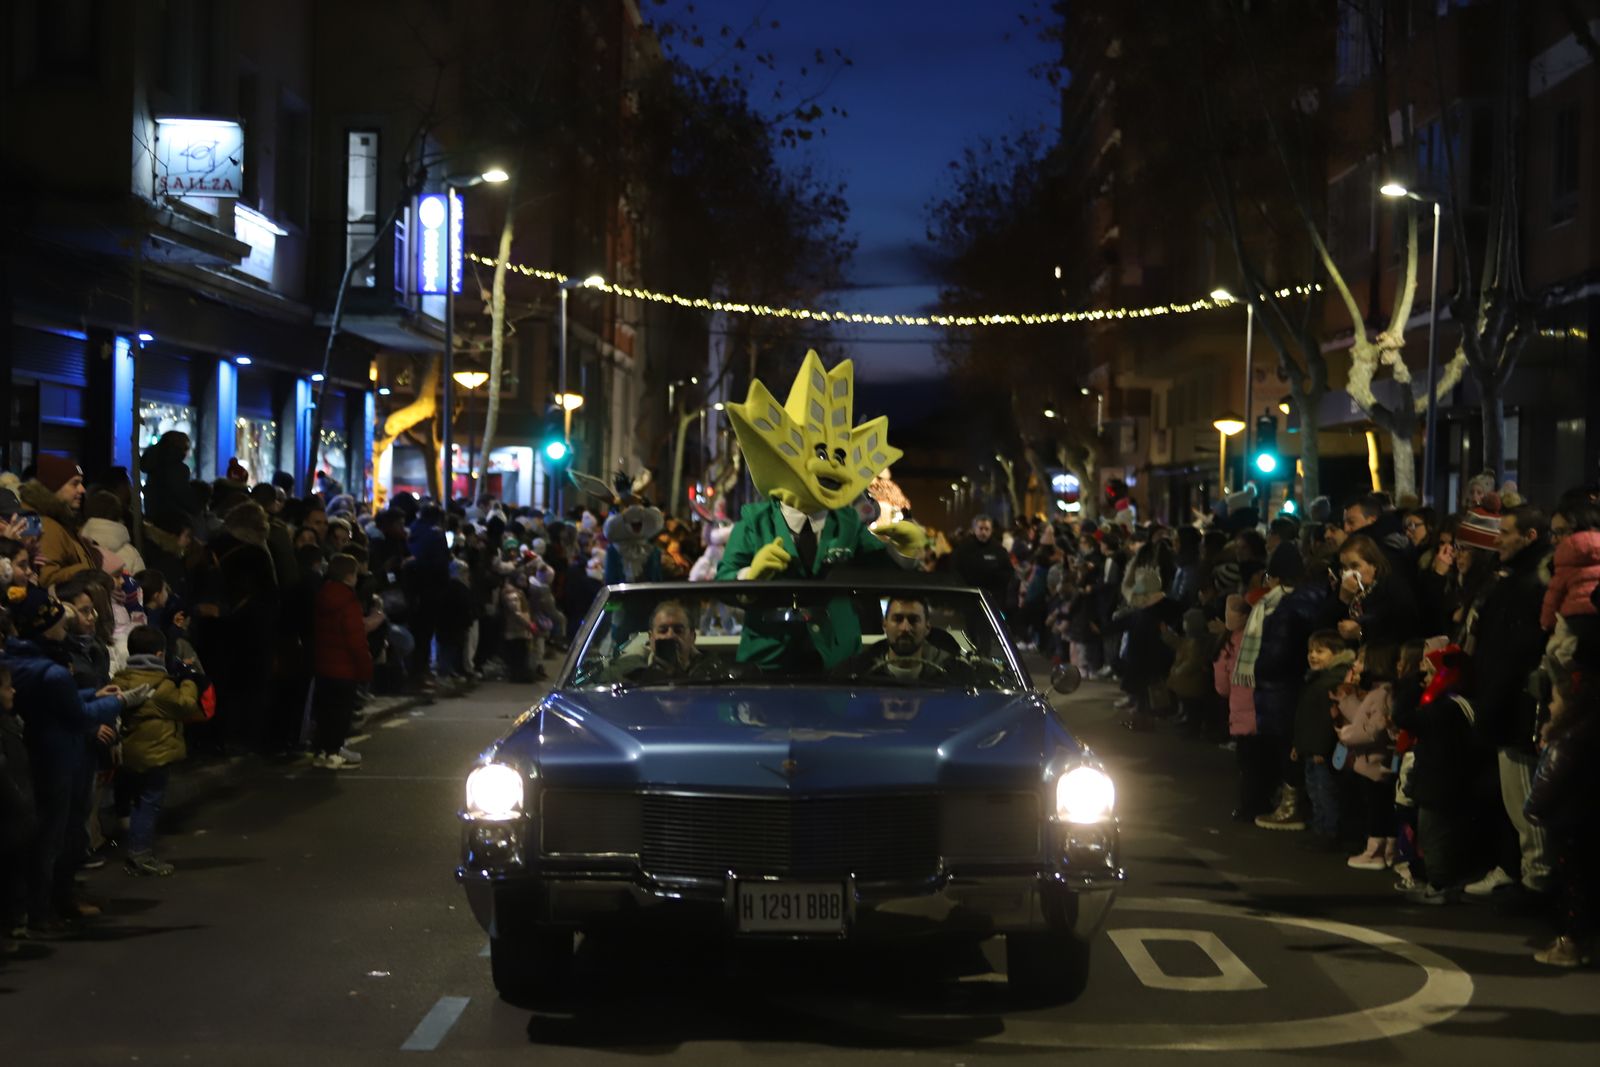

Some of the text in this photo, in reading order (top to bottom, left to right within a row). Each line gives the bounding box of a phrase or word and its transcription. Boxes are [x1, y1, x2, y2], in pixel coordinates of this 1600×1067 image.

[743, 893, 840, 920] H 1291 BBB
[1106, 928, 1268, 991] 0
